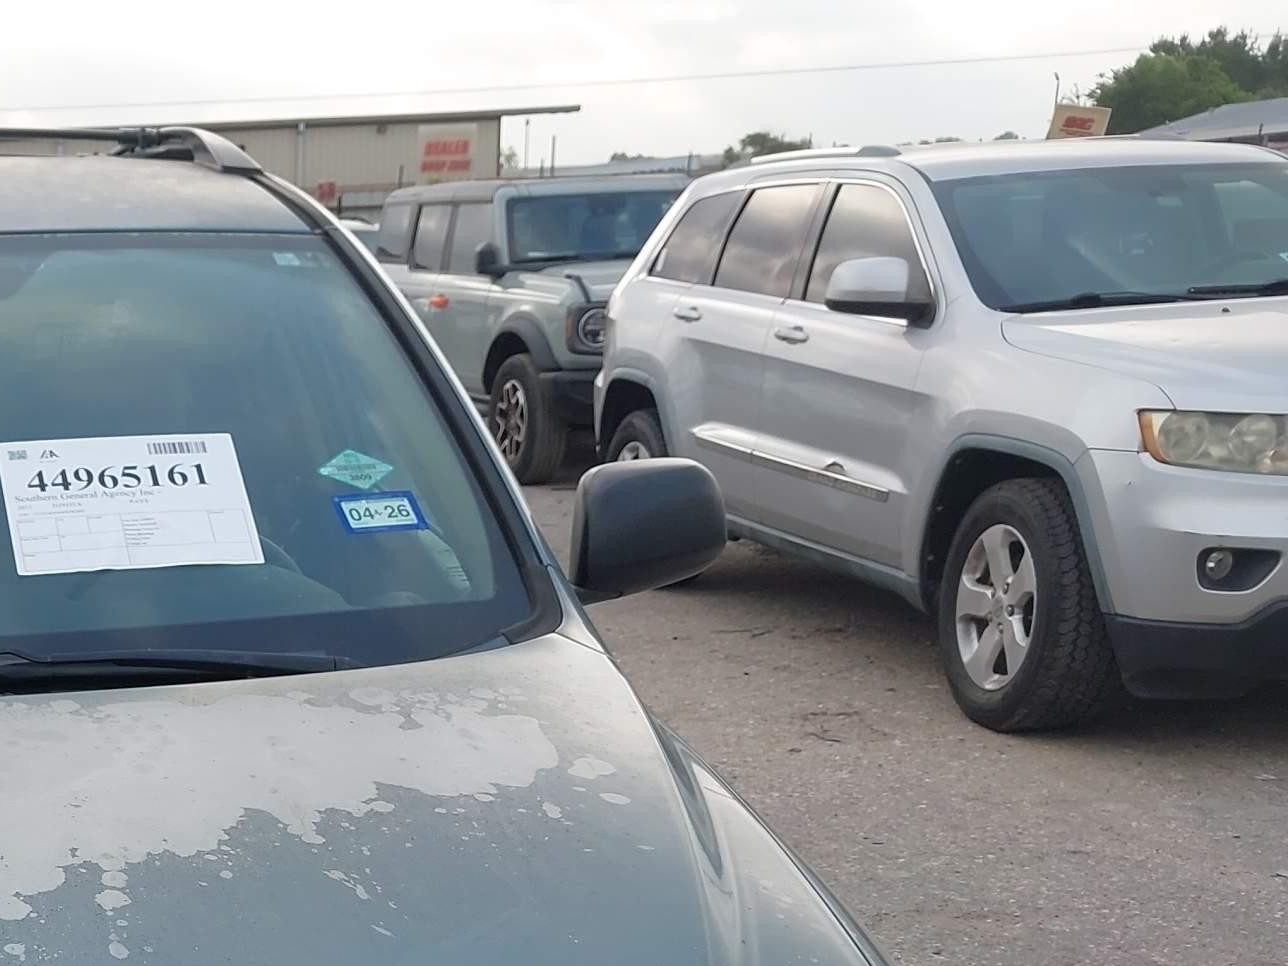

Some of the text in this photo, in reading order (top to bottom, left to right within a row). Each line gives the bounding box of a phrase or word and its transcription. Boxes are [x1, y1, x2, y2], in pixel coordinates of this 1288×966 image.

[27, 463, 209, 492] 44965161
[15, 493, 58, 503] Southern
[61, 490, 98, 500] General
[101, 489, 136, 499] Agency
